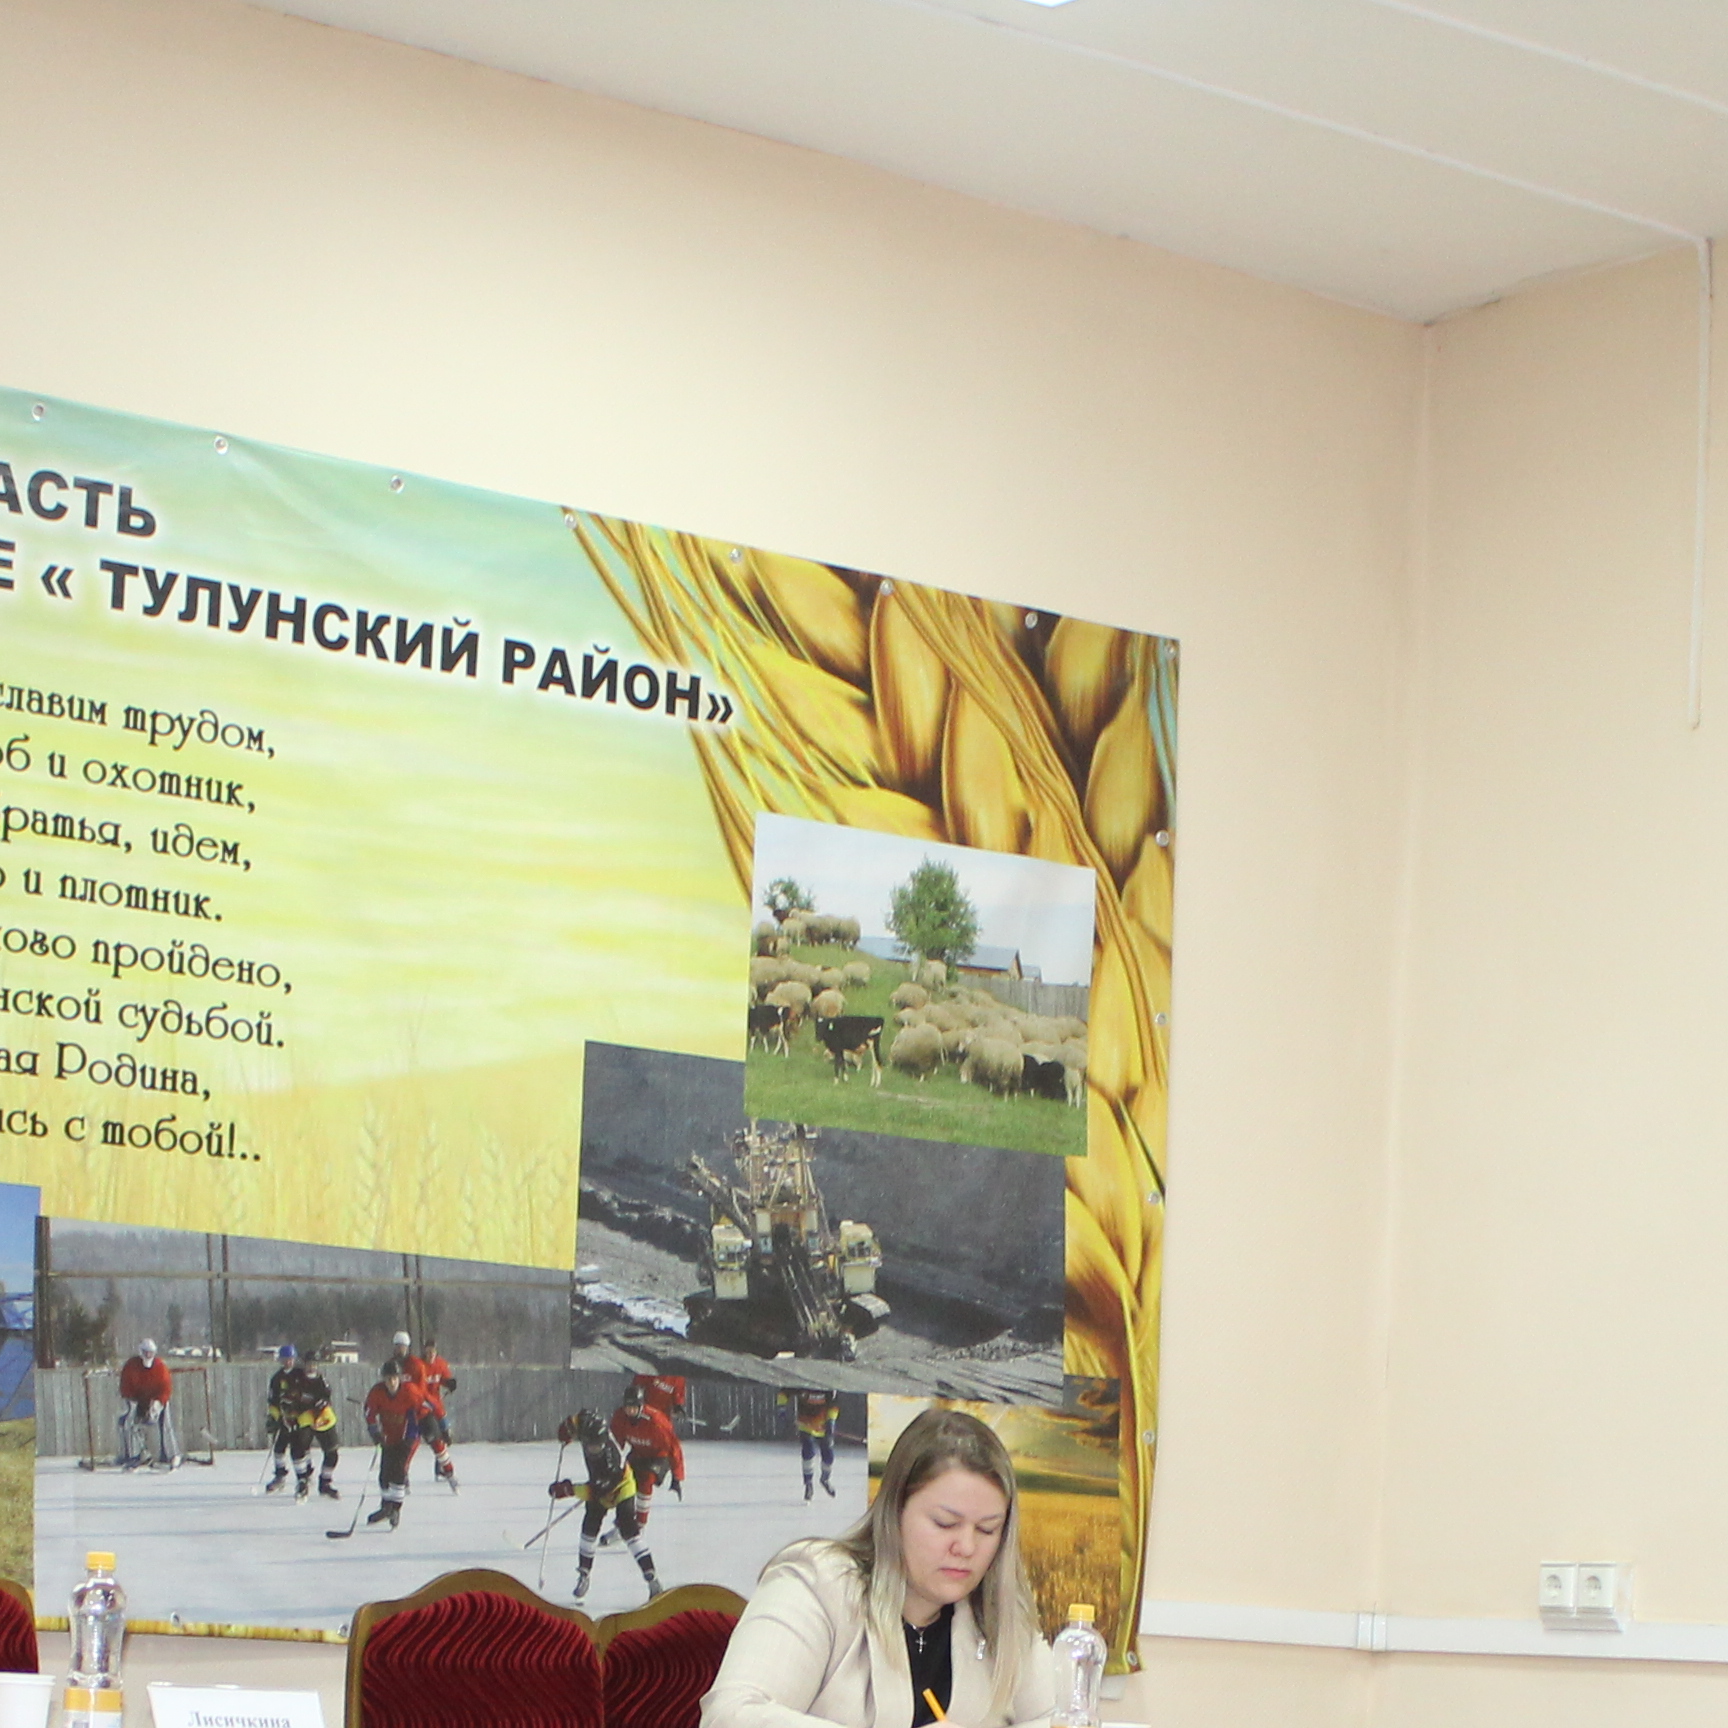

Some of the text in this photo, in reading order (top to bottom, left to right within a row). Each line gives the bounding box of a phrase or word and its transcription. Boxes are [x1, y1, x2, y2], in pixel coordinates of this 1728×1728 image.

[98, 559, 480, 679] ТУЛУНСКИЙ
[500, 638, 737, 729] РАЙОН»
[122, 703, 276, 758] трудом,
[48, 750, 68, 780] и
[82, 759, 257, 814] охотник,
[150, 823, 253, 872] идем,
[23, 865, 44, 896] и
[59, 874, 223, 923] плотник.
[91, 938, 293, 995] пройдено,
[118, 1000, 286, 1049] судьбой.
[54, 1041, 212, 1101] Родина,
[65, 1112, 88, 1143] с
